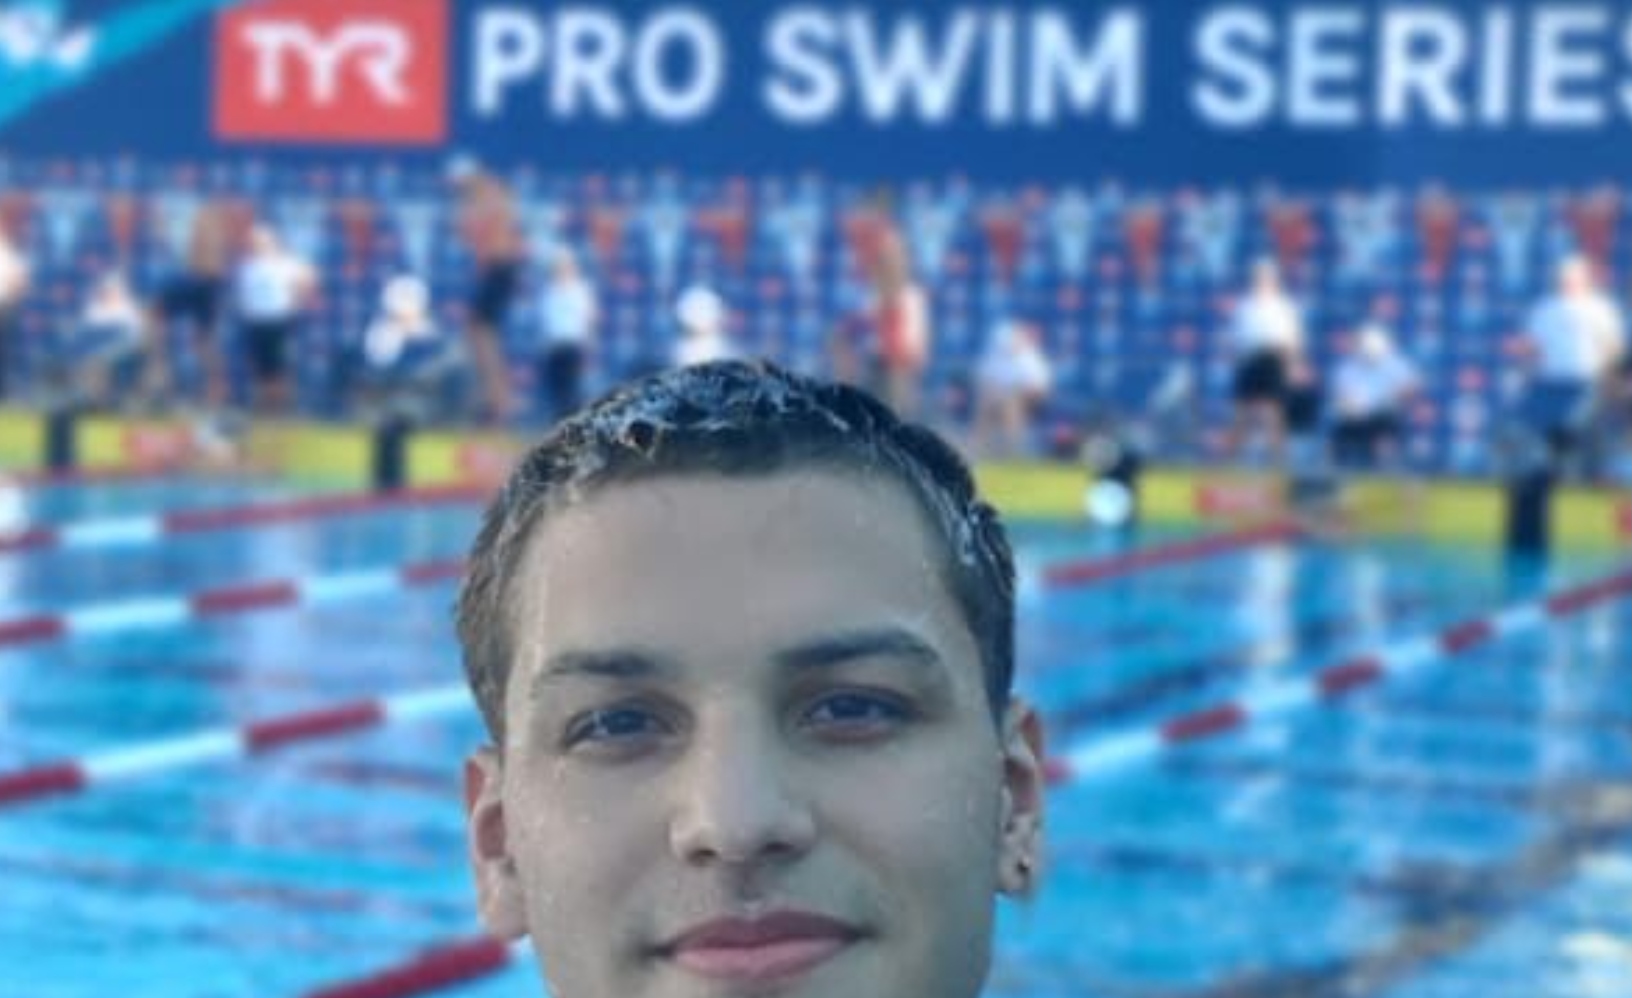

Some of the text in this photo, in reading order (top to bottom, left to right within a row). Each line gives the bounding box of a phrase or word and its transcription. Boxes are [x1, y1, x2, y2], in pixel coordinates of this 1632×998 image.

[240, 22, 416, 106] TYR
[473, 10, 1632, 126] PRO SWIM SERIE
